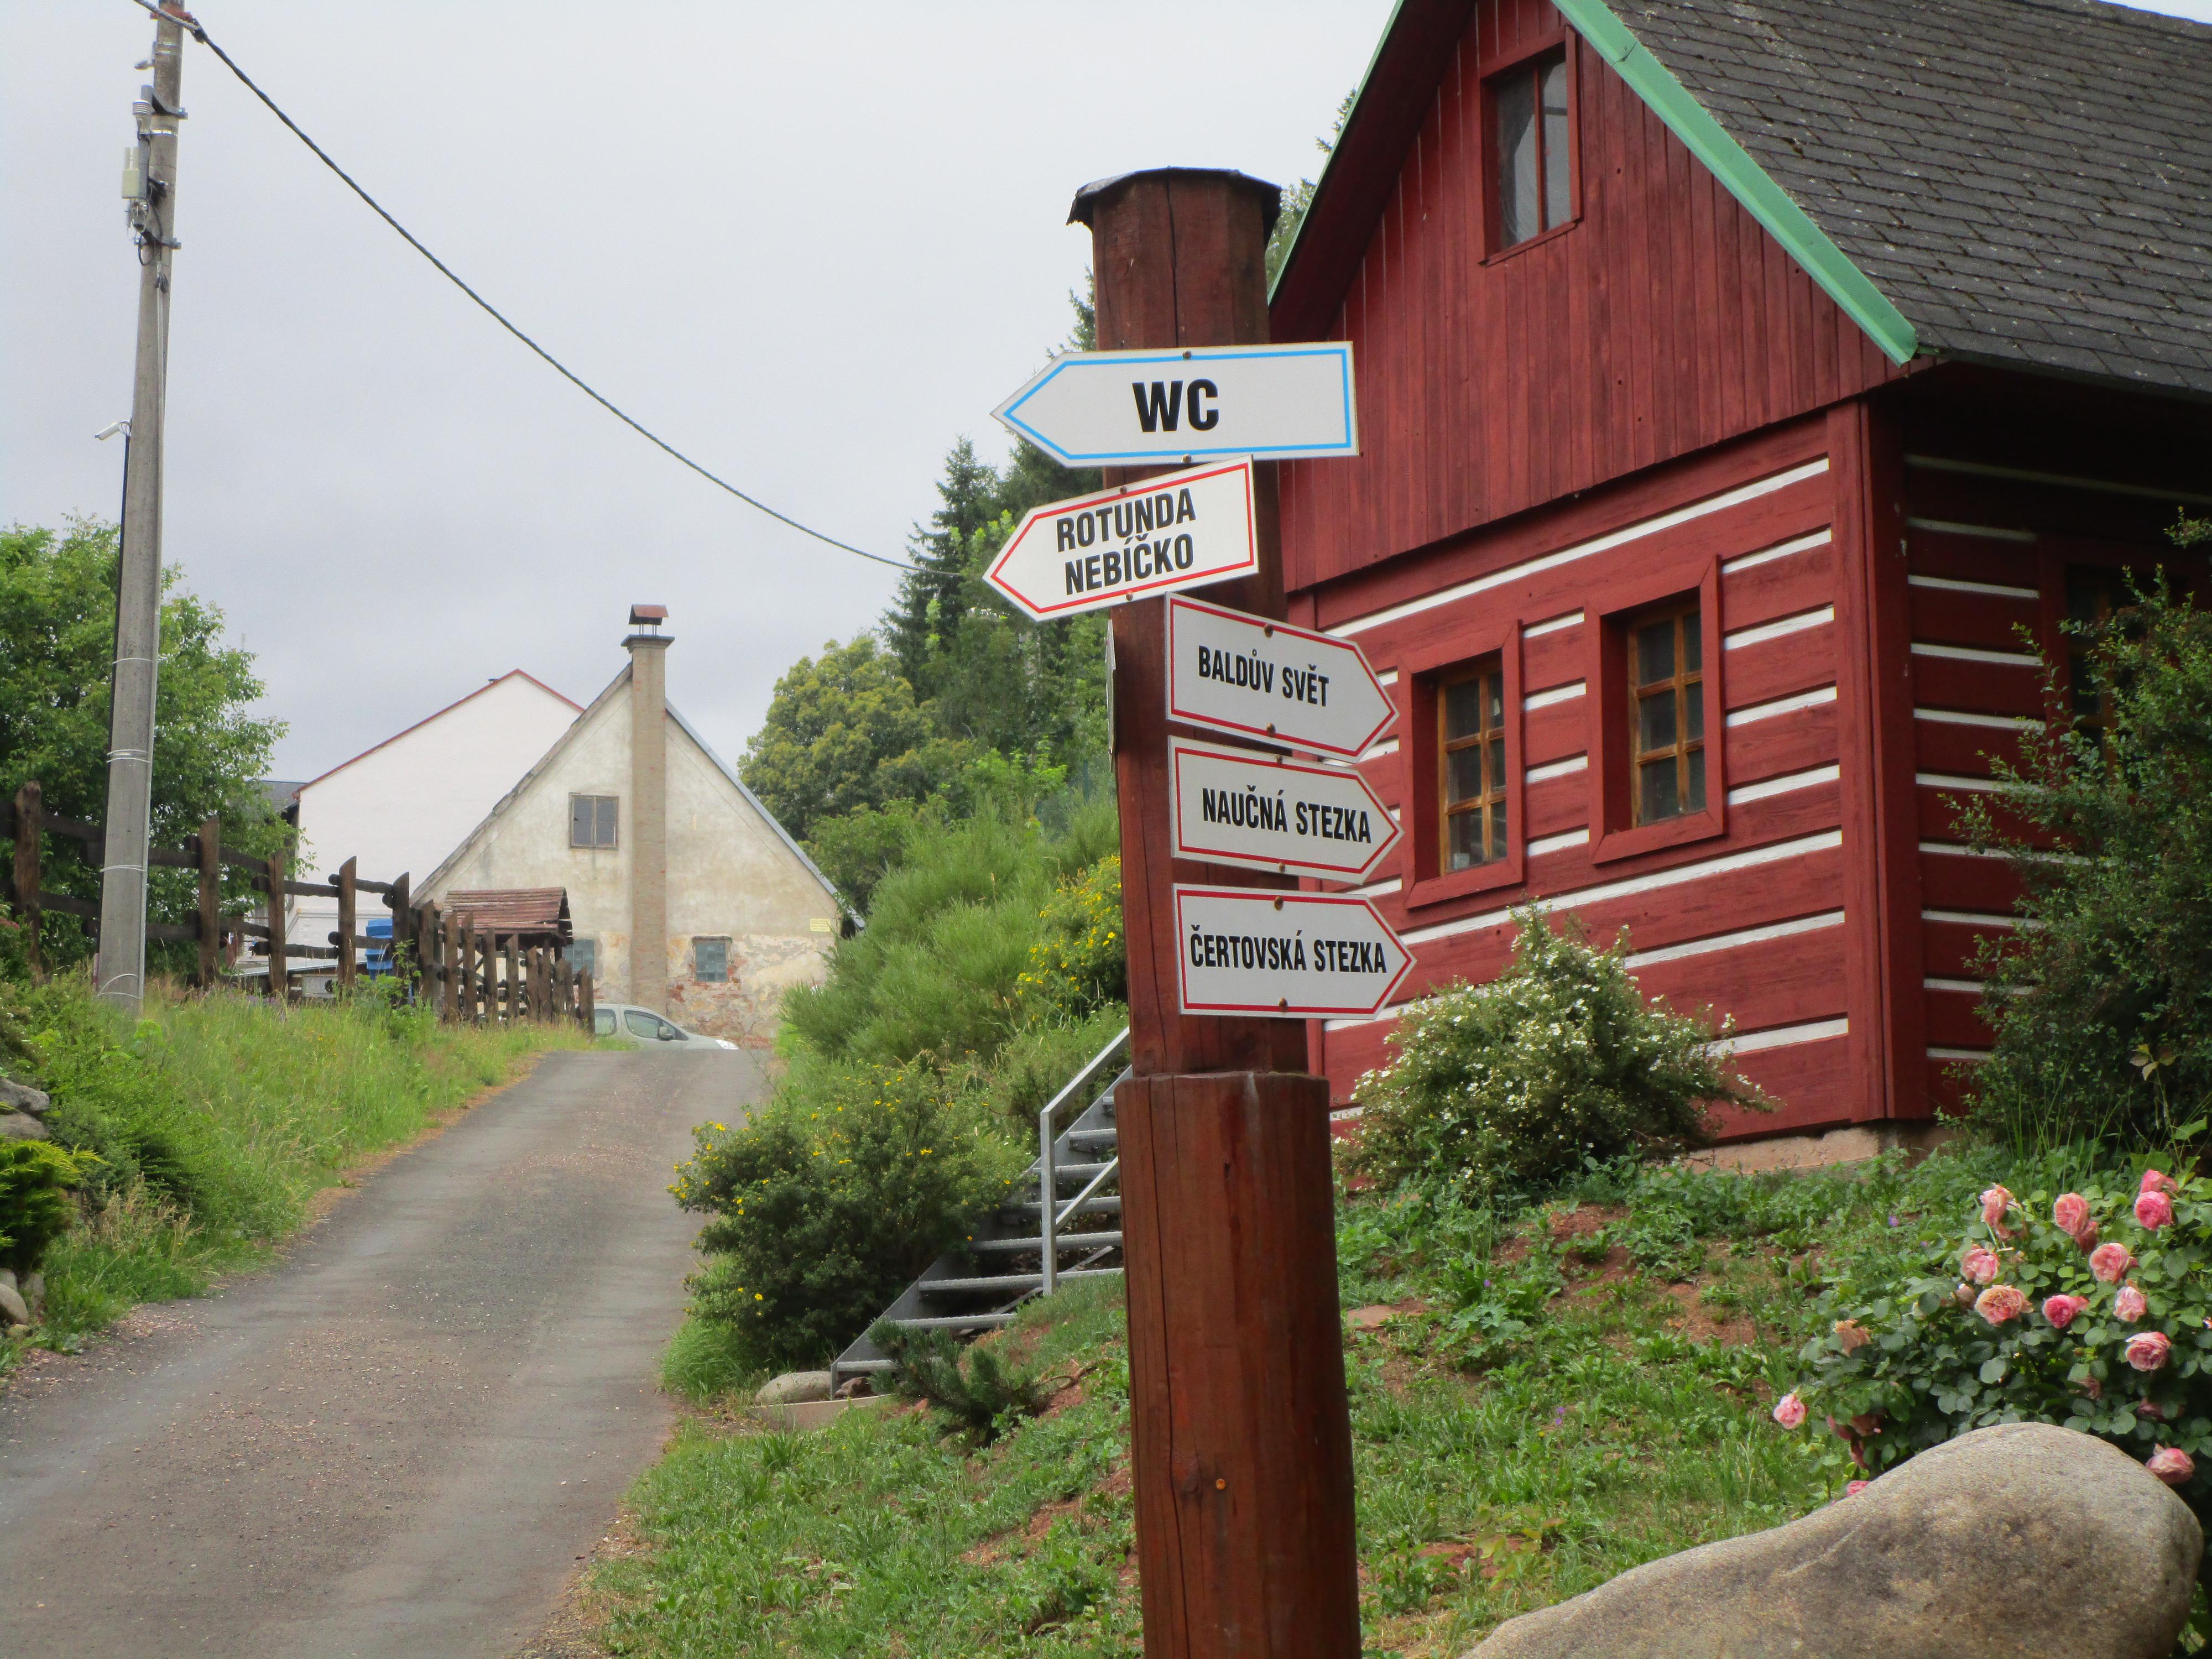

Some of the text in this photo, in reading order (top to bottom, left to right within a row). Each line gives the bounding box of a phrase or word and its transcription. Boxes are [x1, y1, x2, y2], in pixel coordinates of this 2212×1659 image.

[1132, 379, 1219, 433] WC
[1056, 488, 1196, 553] ROTUNDA
[1065, 533, 1194, 596] NEBÍČKO
[1198, 645, 1330, 707] BALDŮV SVĚT
[1202, 784, 1372, 844] NAUČNÁ STEZKA
[1190, 924, 1387, 974] ČERTOVSKÁ STEZKA
